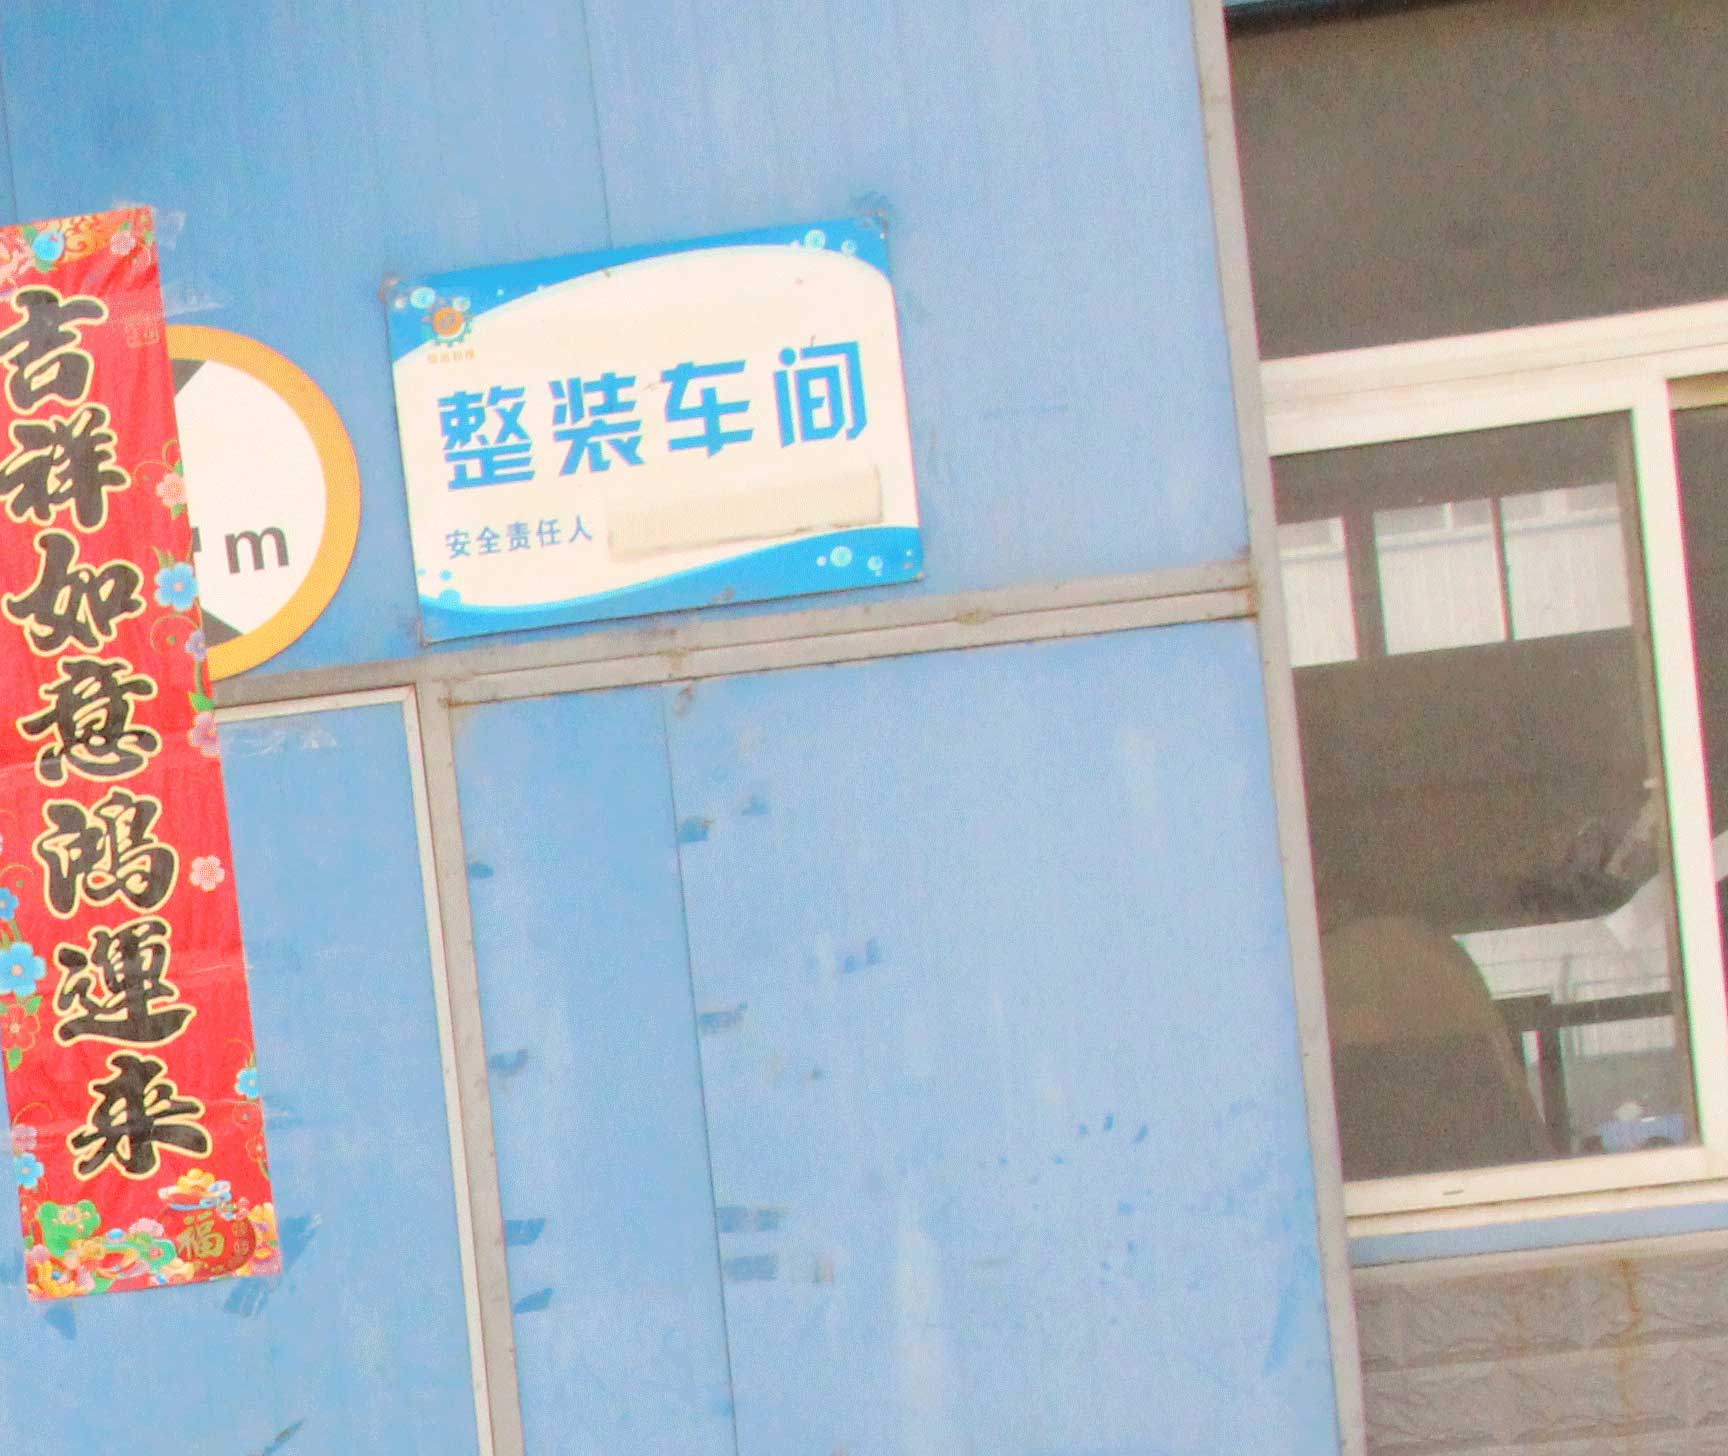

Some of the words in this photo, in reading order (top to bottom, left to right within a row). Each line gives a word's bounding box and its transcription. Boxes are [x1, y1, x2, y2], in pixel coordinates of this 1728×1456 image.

[437, 341, 867, 491] 整装车间
[445, 514, 593, 560] 安全责任人
